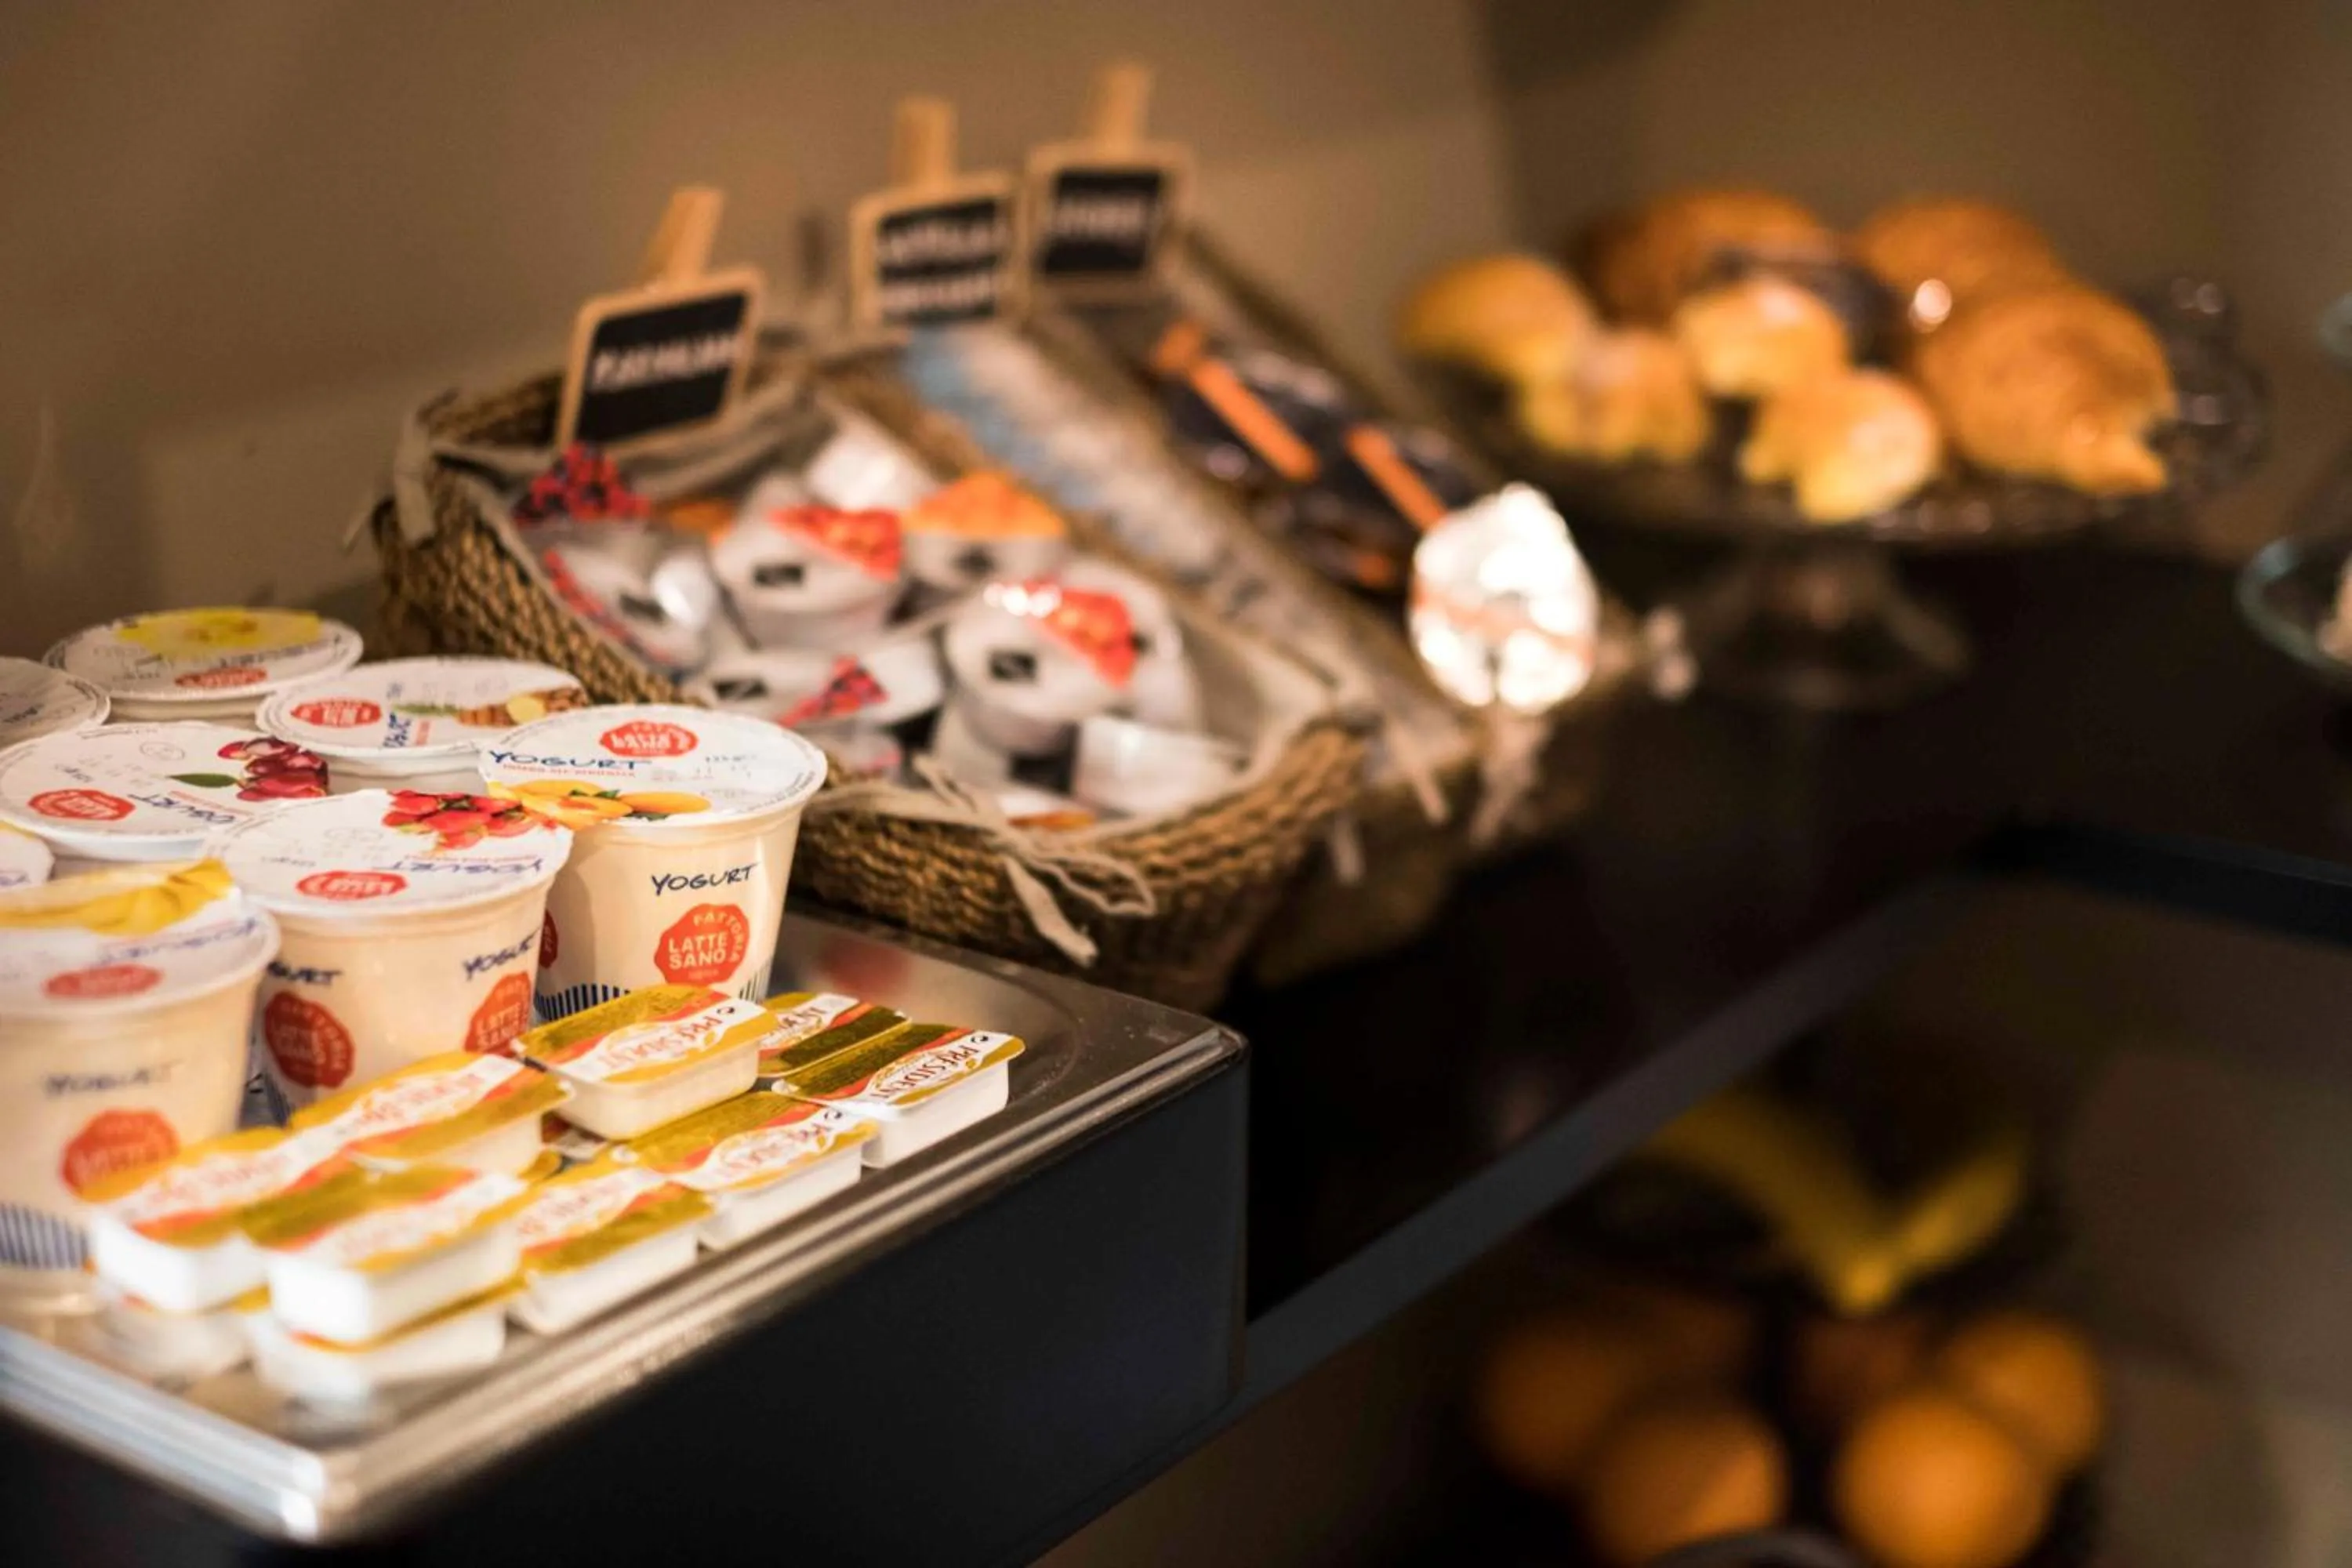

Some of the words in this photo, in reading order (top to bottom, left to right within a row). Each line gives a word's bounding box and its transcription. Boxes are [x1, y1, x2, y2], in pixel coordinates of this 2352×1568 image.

[489, 750, 652, 770] YOGURT
[651, 862, 761, 897] YOGURT
[668, 931, 728, 953] LATTE
[669, 949, 727, 970] SANO
